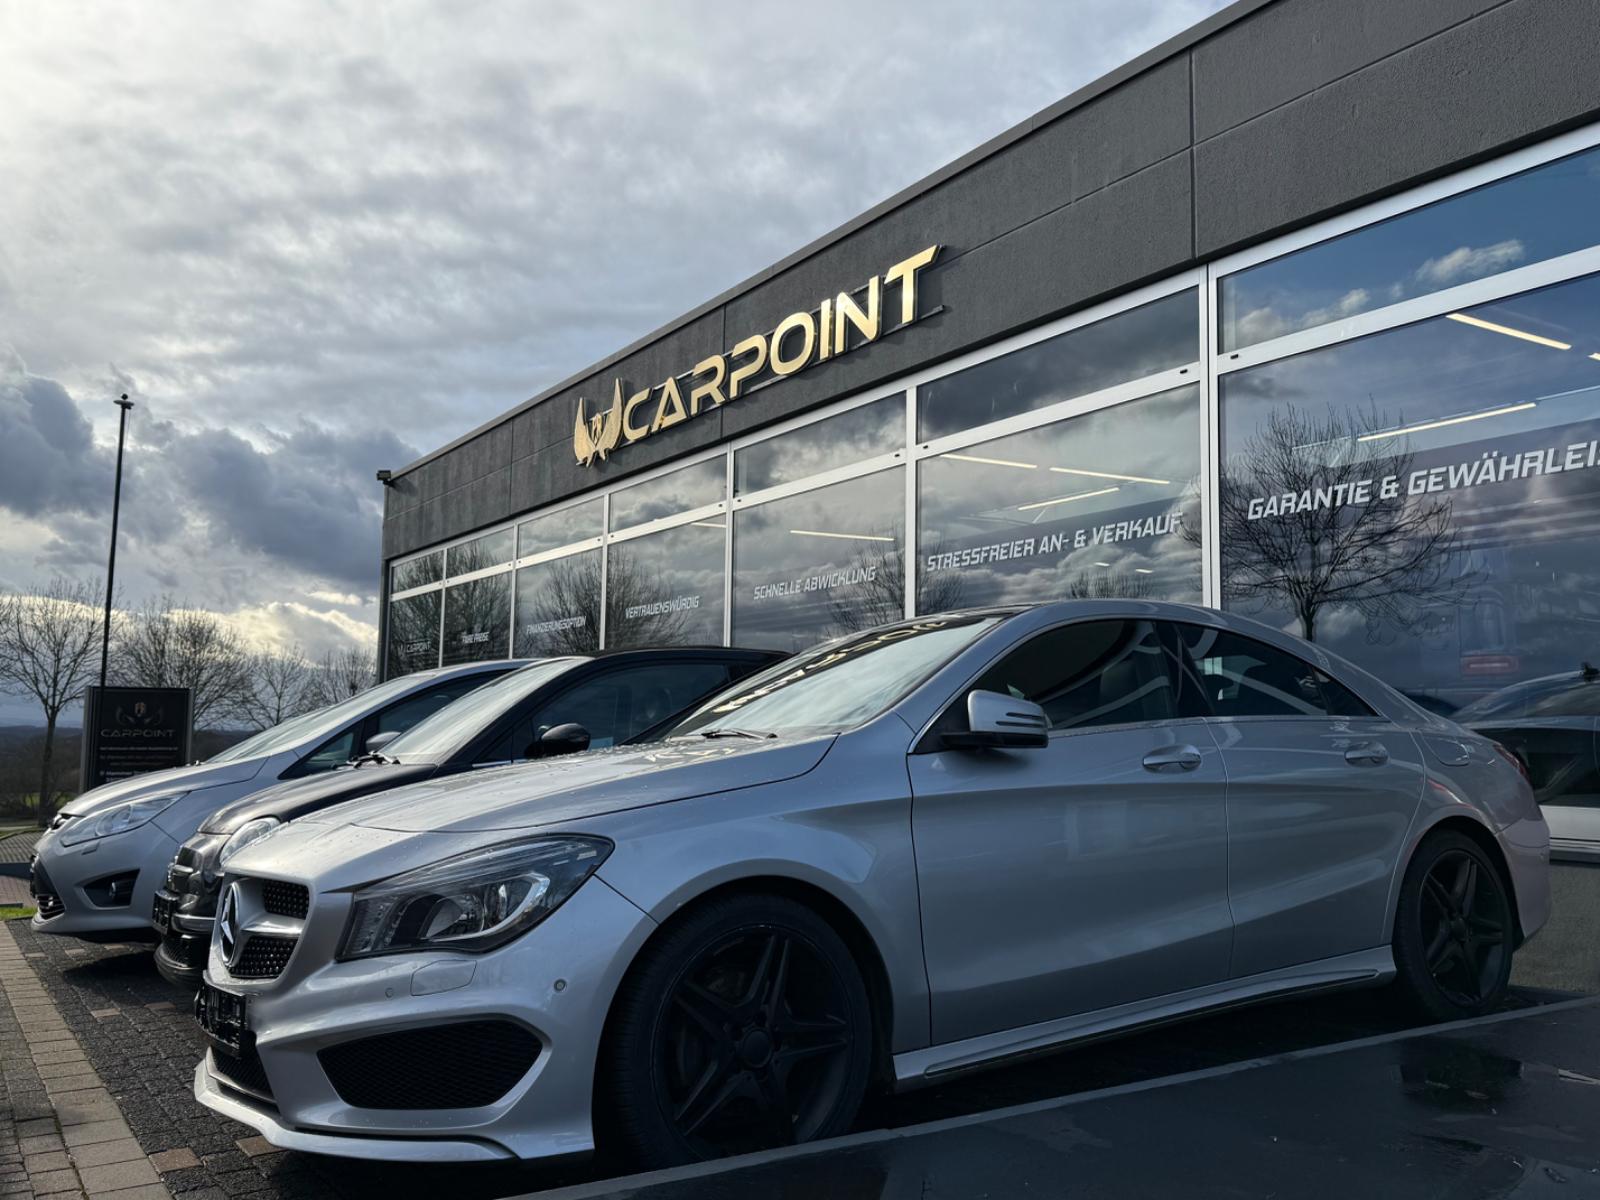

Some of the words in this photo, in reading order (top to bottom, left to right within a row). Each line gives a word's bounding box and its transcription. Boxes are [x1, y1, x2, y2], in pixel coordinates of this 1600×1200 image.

[622, 244, 940, 442] CARPOINT
[1247, 480, 1372, 521] GARANTIE
[1380, 475, 1399, 501] &
[1408, 439, 1600, 495] GEWÄHRLEI
[926, 537, 1035, 572] STRESSFREIER
[1039, 533, 1070, 555] AN-
[1074, 529, 1087, 549] &
[1092, 511, 1184, 545] VERKAUF
[625, 595, 700, 620] VERTRAUENSWÜRDIG
[753, 579, 802, 601] SCHNELLE
[803, 566, 876, 593] ABWICKLUNG
[100, 729, 175, 738] CARPOINT
